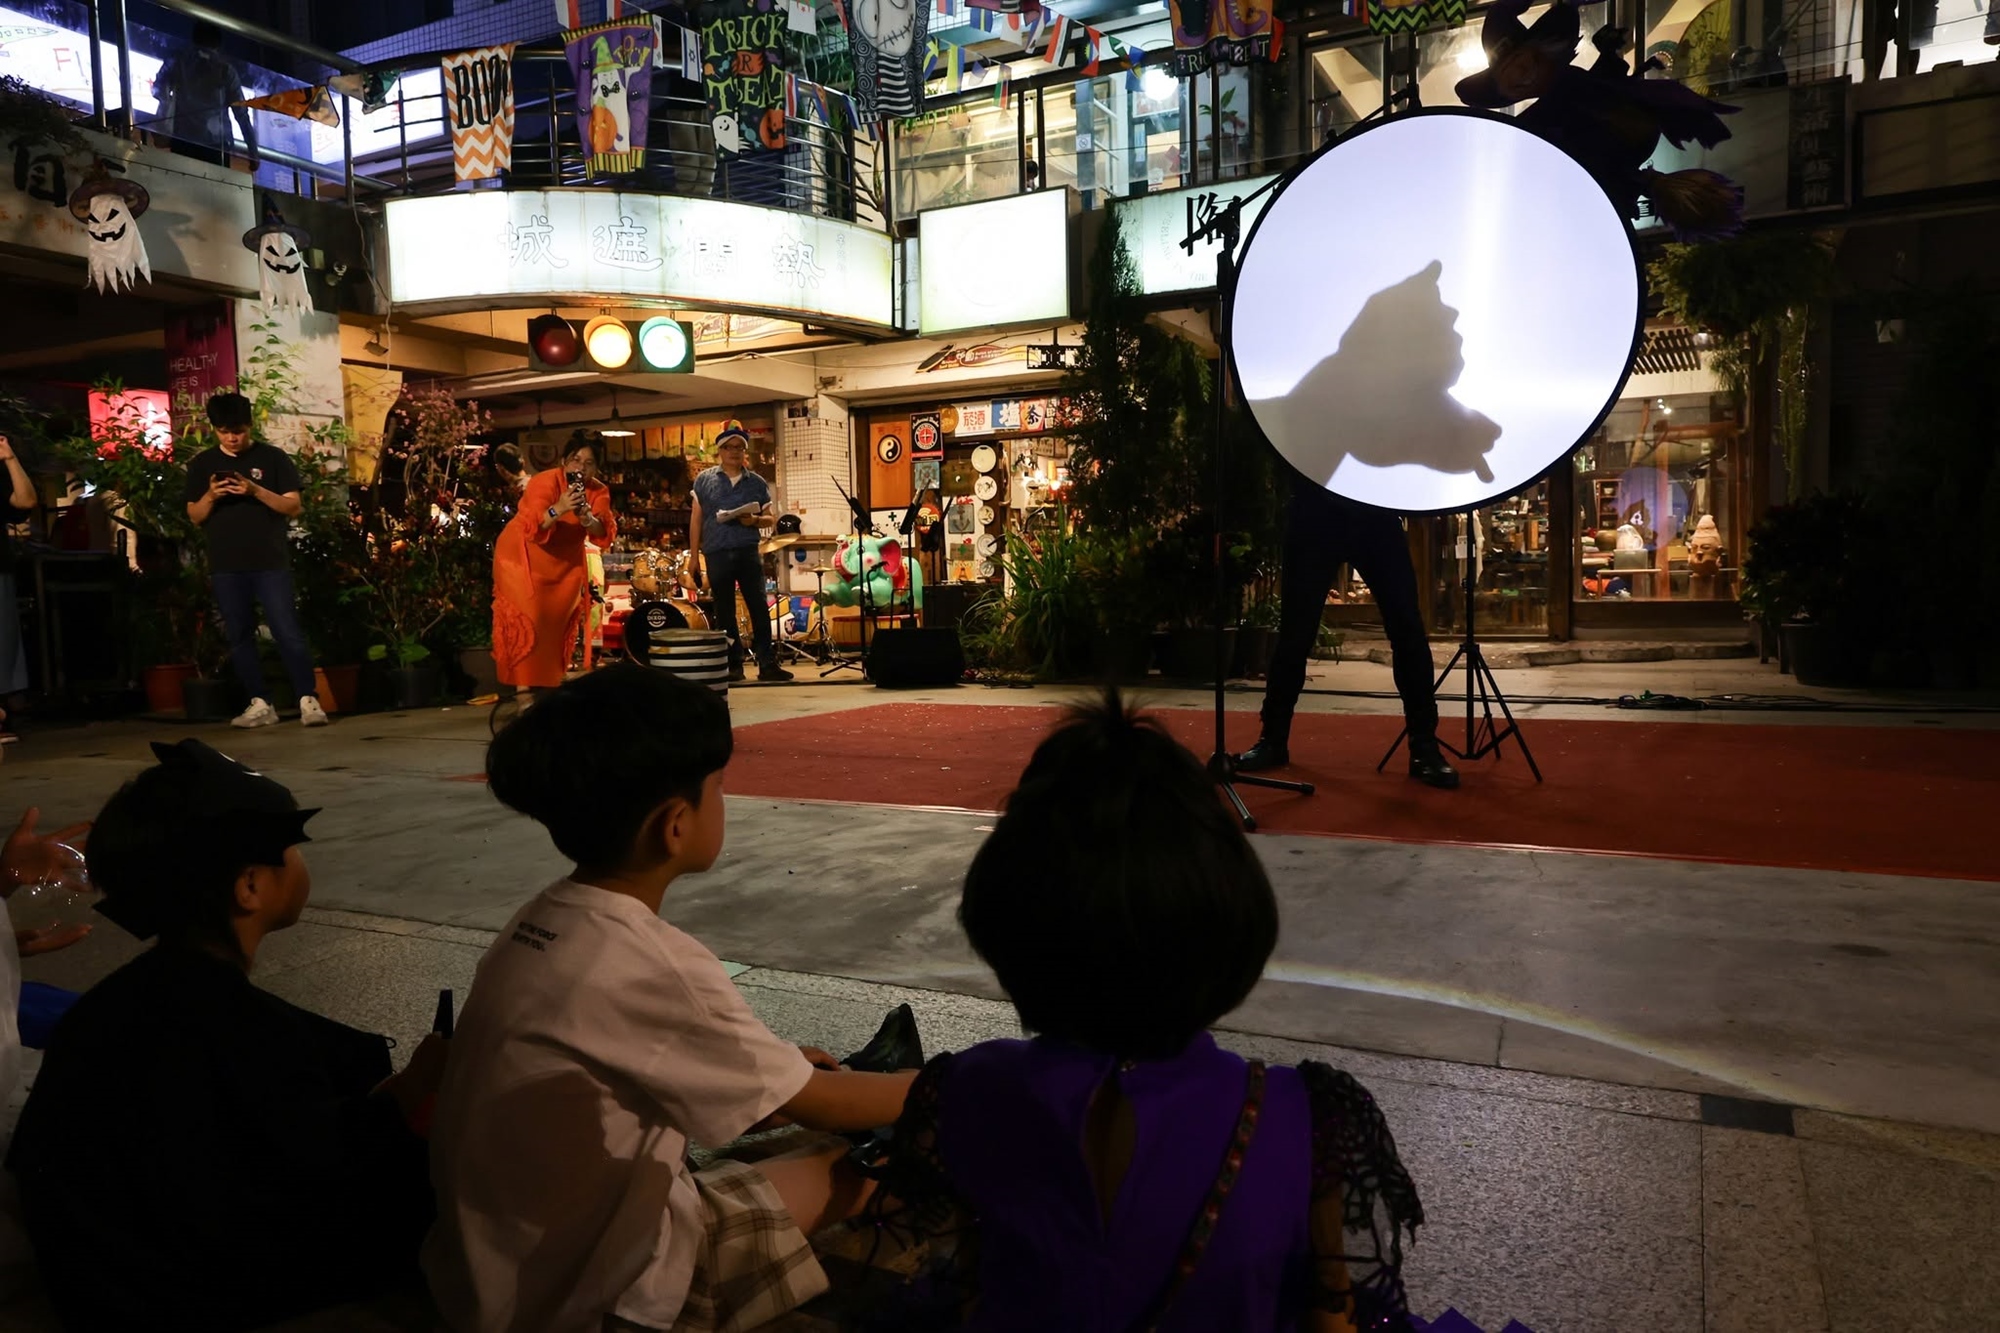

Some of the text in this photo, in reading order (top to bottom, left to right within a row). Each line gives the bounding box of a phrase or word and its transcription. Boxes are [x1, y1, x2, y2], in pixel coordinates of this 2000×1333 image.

[702, 13, 786, 59] TRICK
[741, 54, 754, 73] R
[170, 352, 218, 373] HEALTHY
